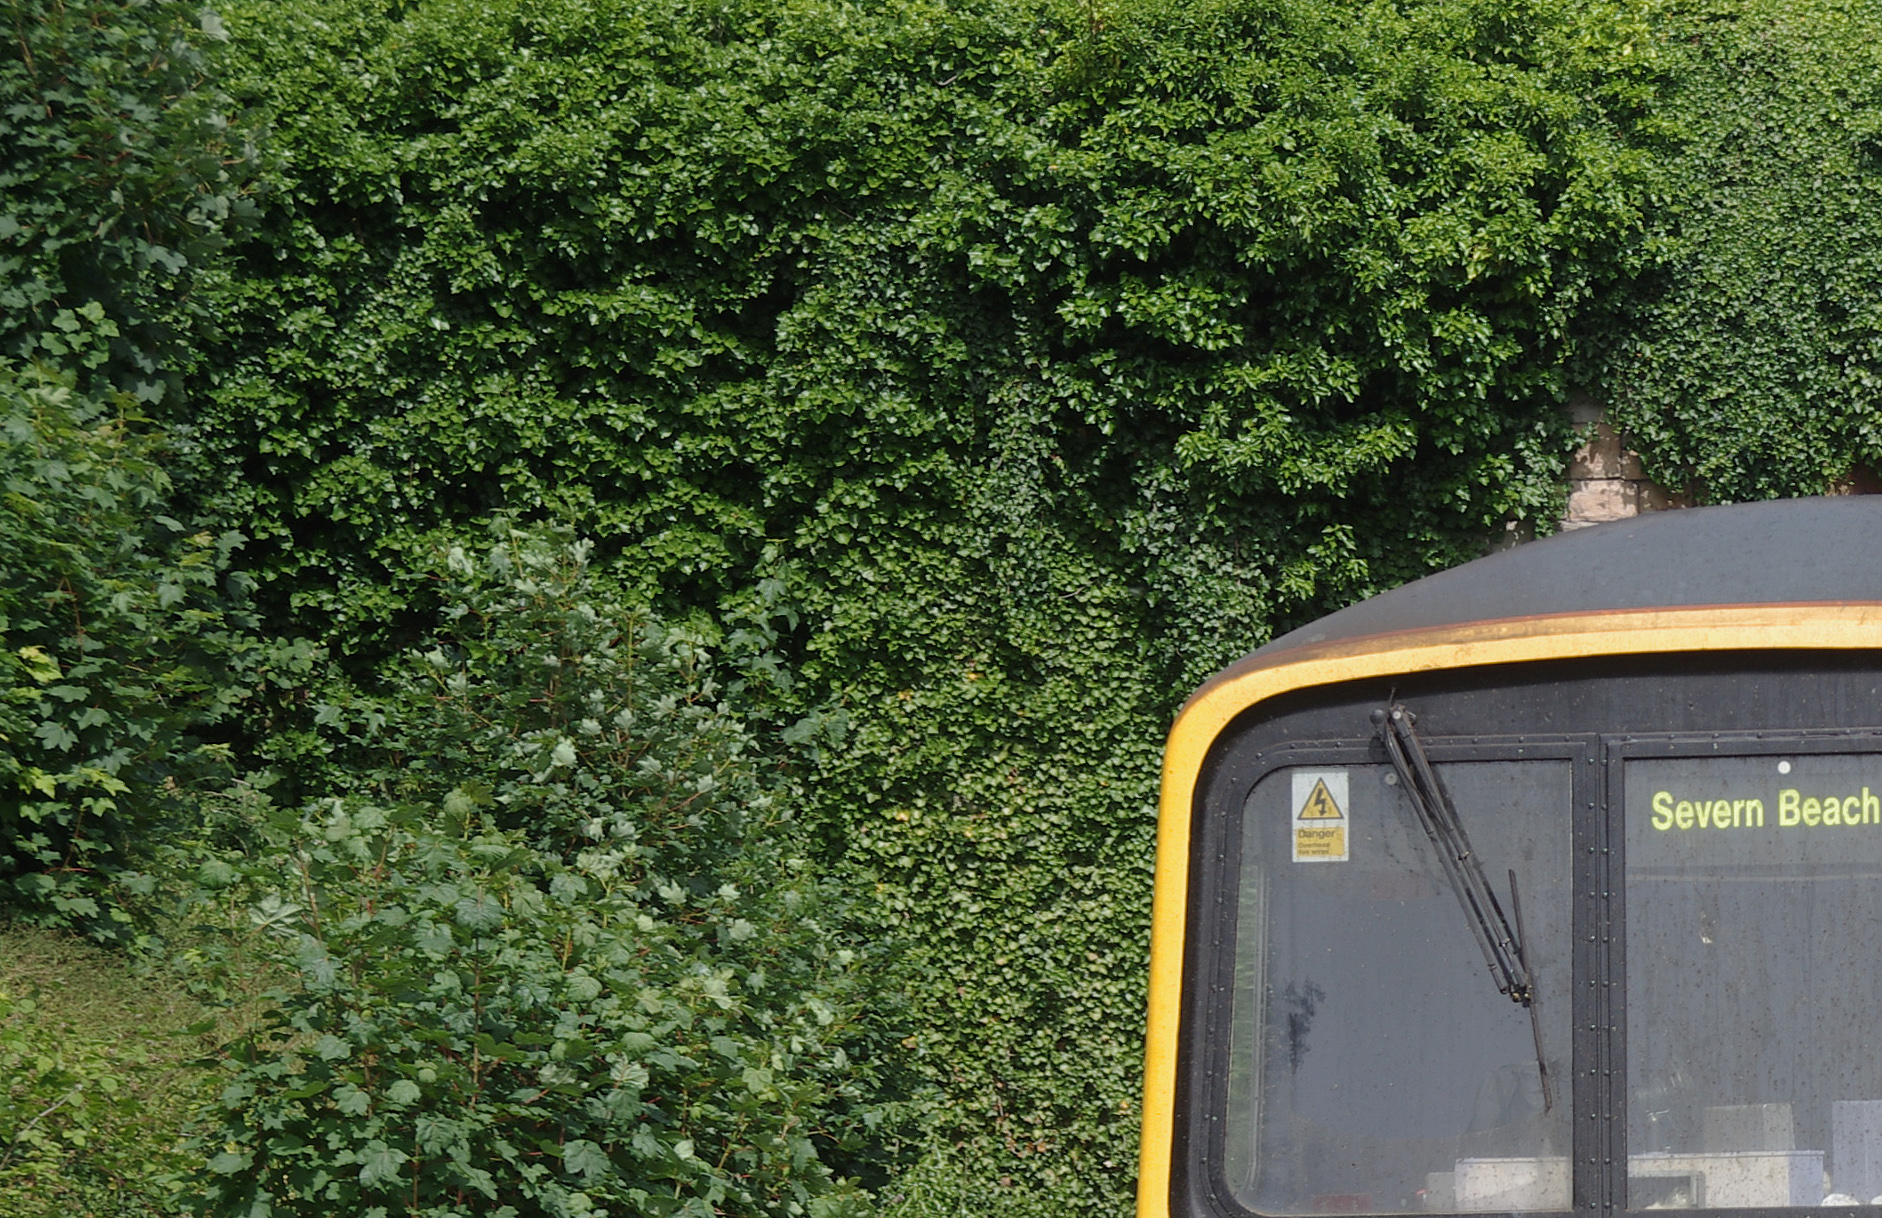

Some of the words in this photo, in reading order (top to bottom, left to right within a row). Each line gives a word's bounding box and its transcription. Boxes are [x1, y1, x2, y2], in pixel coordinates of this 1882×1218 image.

[1651, 790, 1764, 831] Severn
[1778, 787, 1881, 827] Beach
[1298, 829, 1336, 839] Danger
